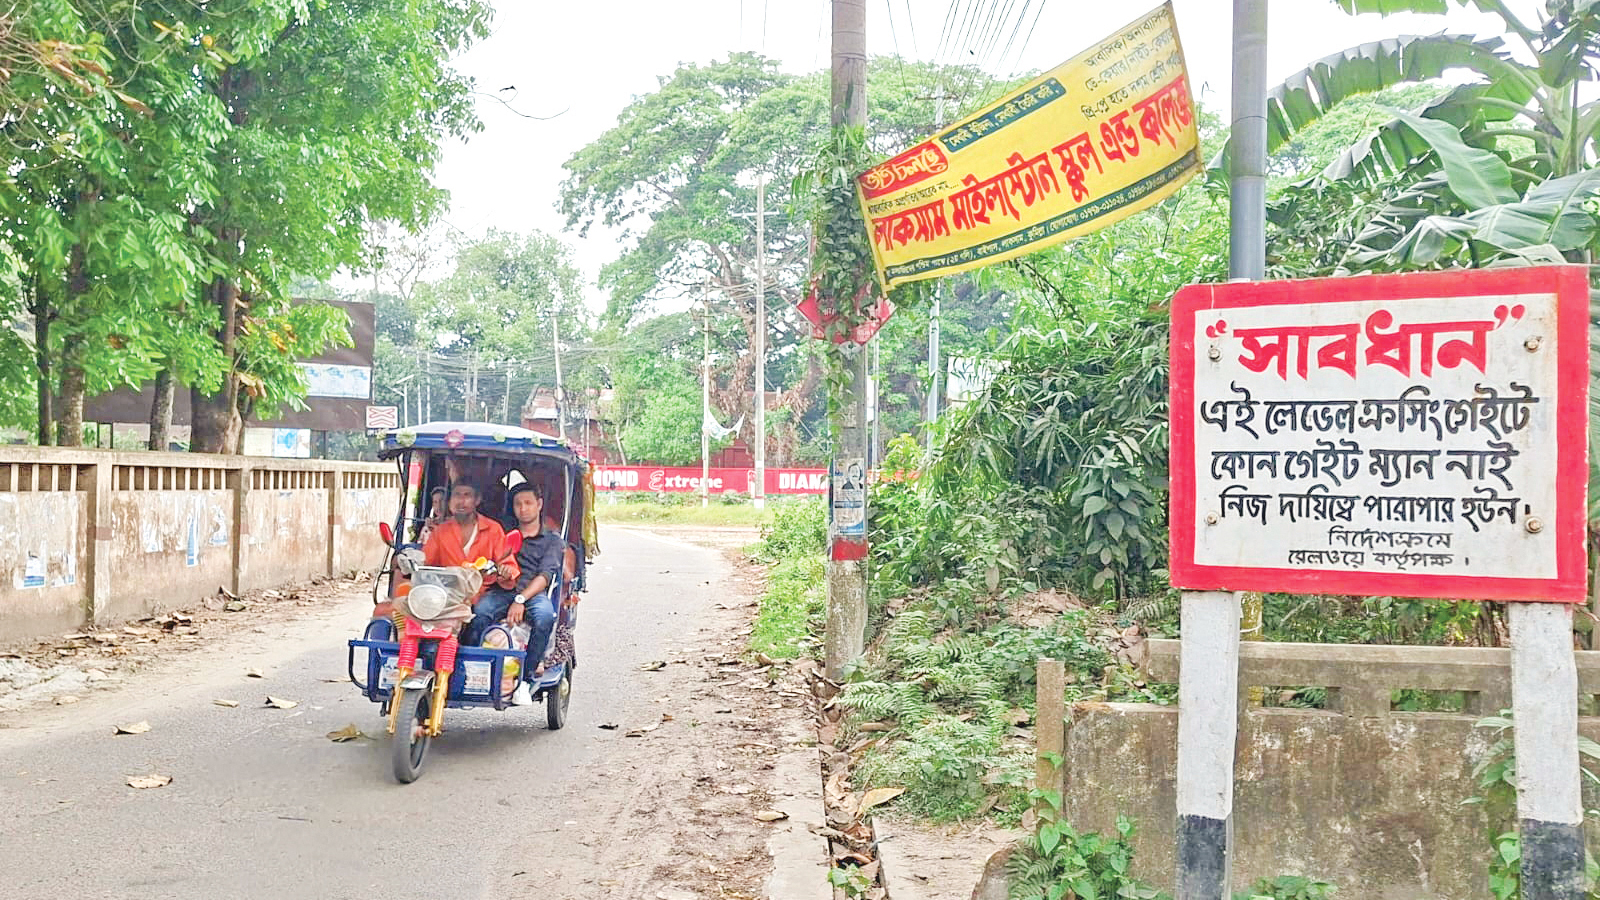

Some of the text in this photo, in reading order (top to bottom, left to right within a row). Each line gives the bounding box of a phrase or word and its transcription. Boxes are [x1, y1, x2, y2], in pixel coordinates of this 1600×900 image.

[871, 199, 951, 251] লাকসাম
[948, 151, 1061, 230] মাইলস্টোন
[1051, 131, 1104, 203] স্কুল
[1100, 110, 1139, 163] এন্ড
[892, 148, 948, 181] চলছে
[1200, 380, 1540, 441] এই লেভেল ক্রসিং গেইটে
[648, 470, 722, 490] Extreme
[779, 473, 829, 489] DIAM
[1211, 438, 1520, 491] কোন গেইট ম্যান নাই
[1219, 485, 1272, 525] নিজ
[1278, 484, 1361, 523] দায়িত্বে
[1364, 495, 1455, 524] পারাপার
[1327, 524, 1454, 549] নির্দেশক্রমে
[1288, 550, 1365, 568] রেলওয়ে
